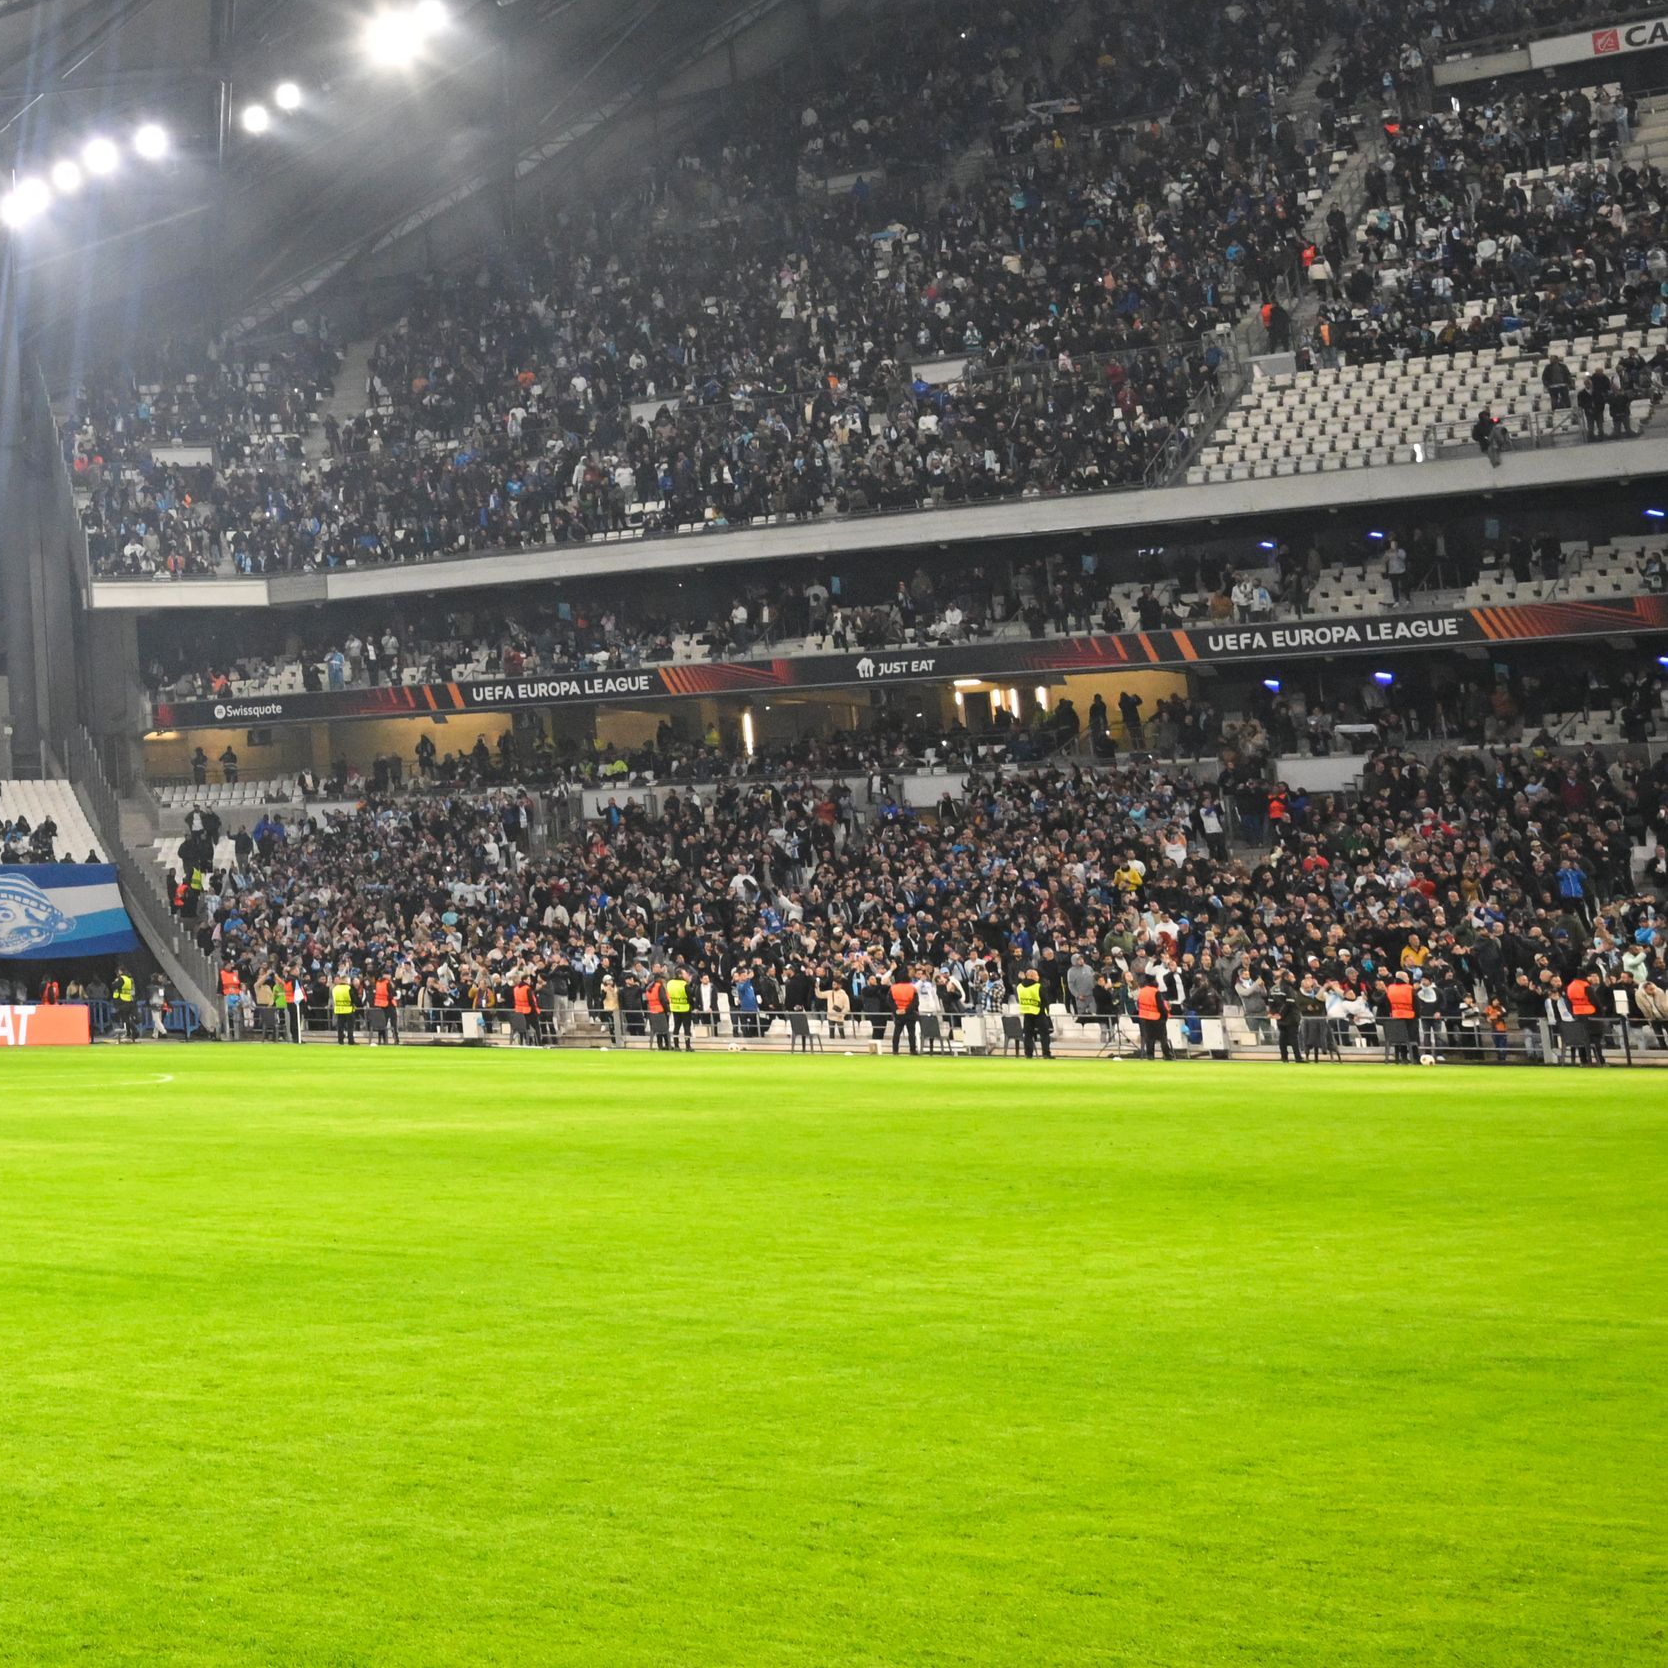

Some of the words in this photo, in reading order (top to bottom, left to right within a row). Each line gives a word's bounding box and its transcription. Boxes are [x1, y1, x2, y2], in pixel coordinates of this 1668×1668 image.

[1207, 632, 1267, 652] UEFA
[1272, 625, 1361, 648] EUROPA
[1366, 618, 1459, 641] LEAGUE
[878, 661, 908, 677] JUST
[911, 659, 935, 673] EAT
[472, 684, 514, 702] UEFA
[517, 681, 581, 699] EUROPA
[584, 675, 650, 694] LEAGUE
[226, 702, 282, 718] Swissquote
